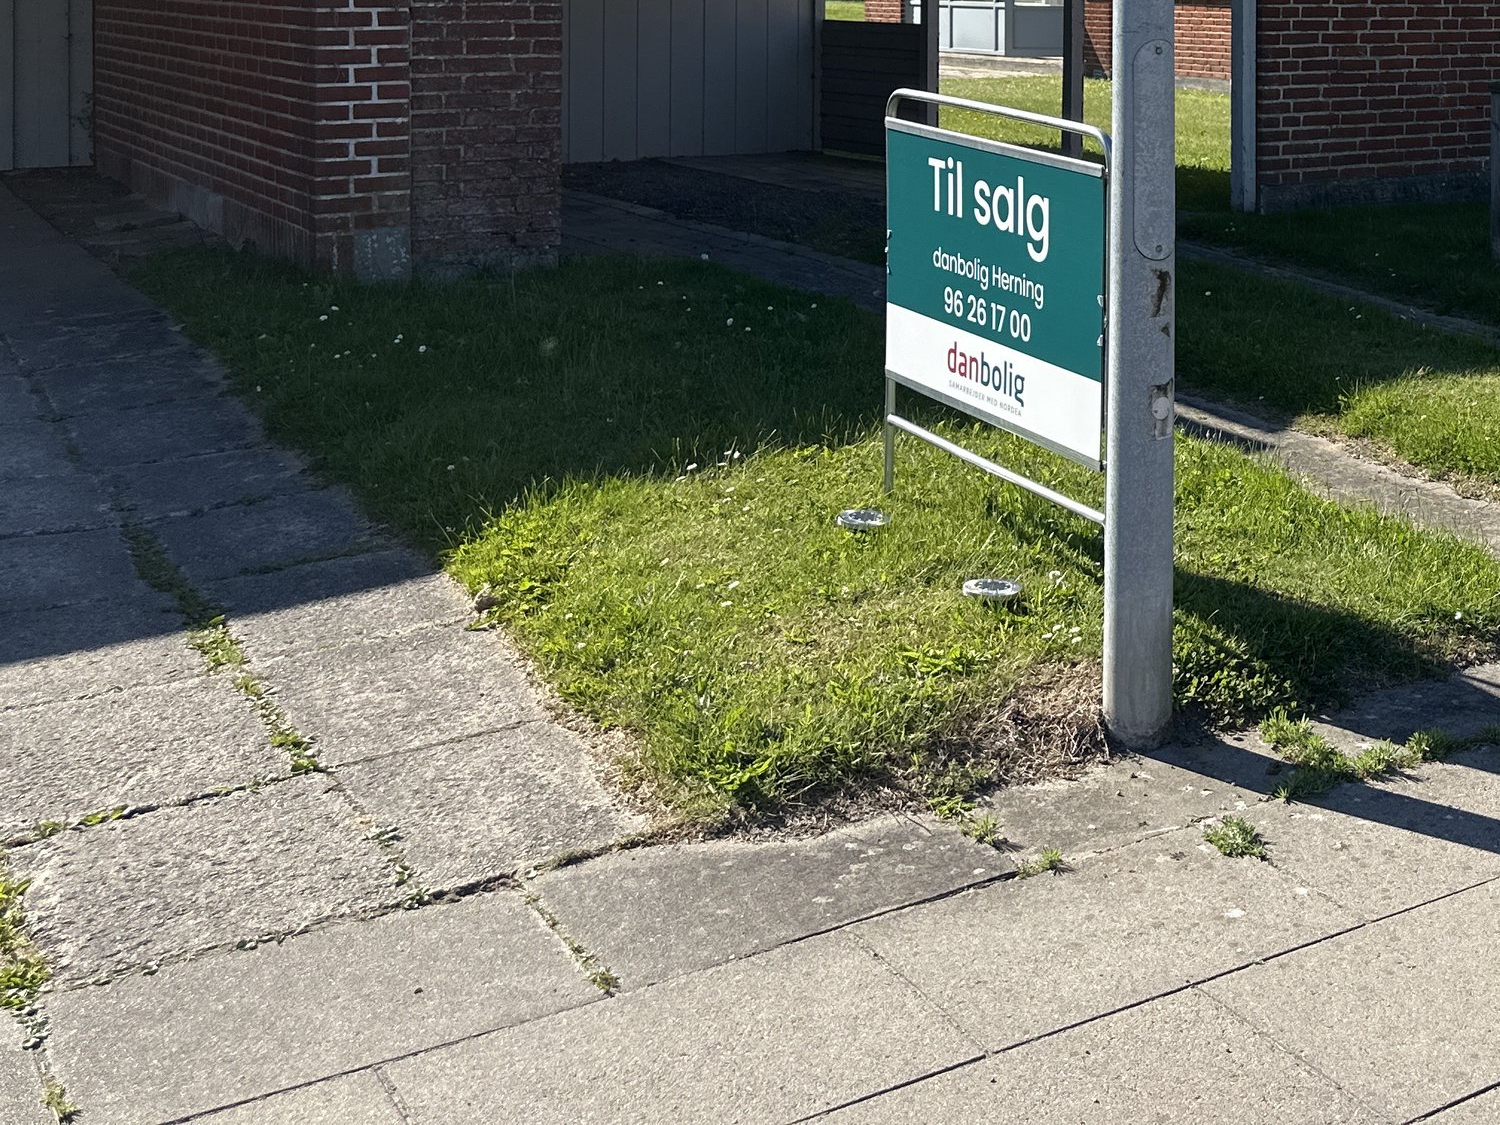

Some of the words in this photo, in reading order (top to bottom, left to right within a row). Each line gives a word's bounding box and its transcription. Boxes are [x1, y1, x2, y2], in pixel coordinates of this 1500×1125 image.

[928, 156, 963, 219] Til
[973, 175, 1050, 263] salg
[932, 246, 989, 291] danbolig
[991, 263, 1044, 310] Herning
[943, 285, 964, 318] 96
[966, 294, 987, 327] 26
[990, 302, 1006, 333] 17
[1009, 309, 1031, 343] 00
[947, 340, 1025, 408] danbolig
[948, 379, 986, 402] SAMARBEJDER
[986, 395, 998, 406] MED
[999, 402, 1022, 417] NORDEA
